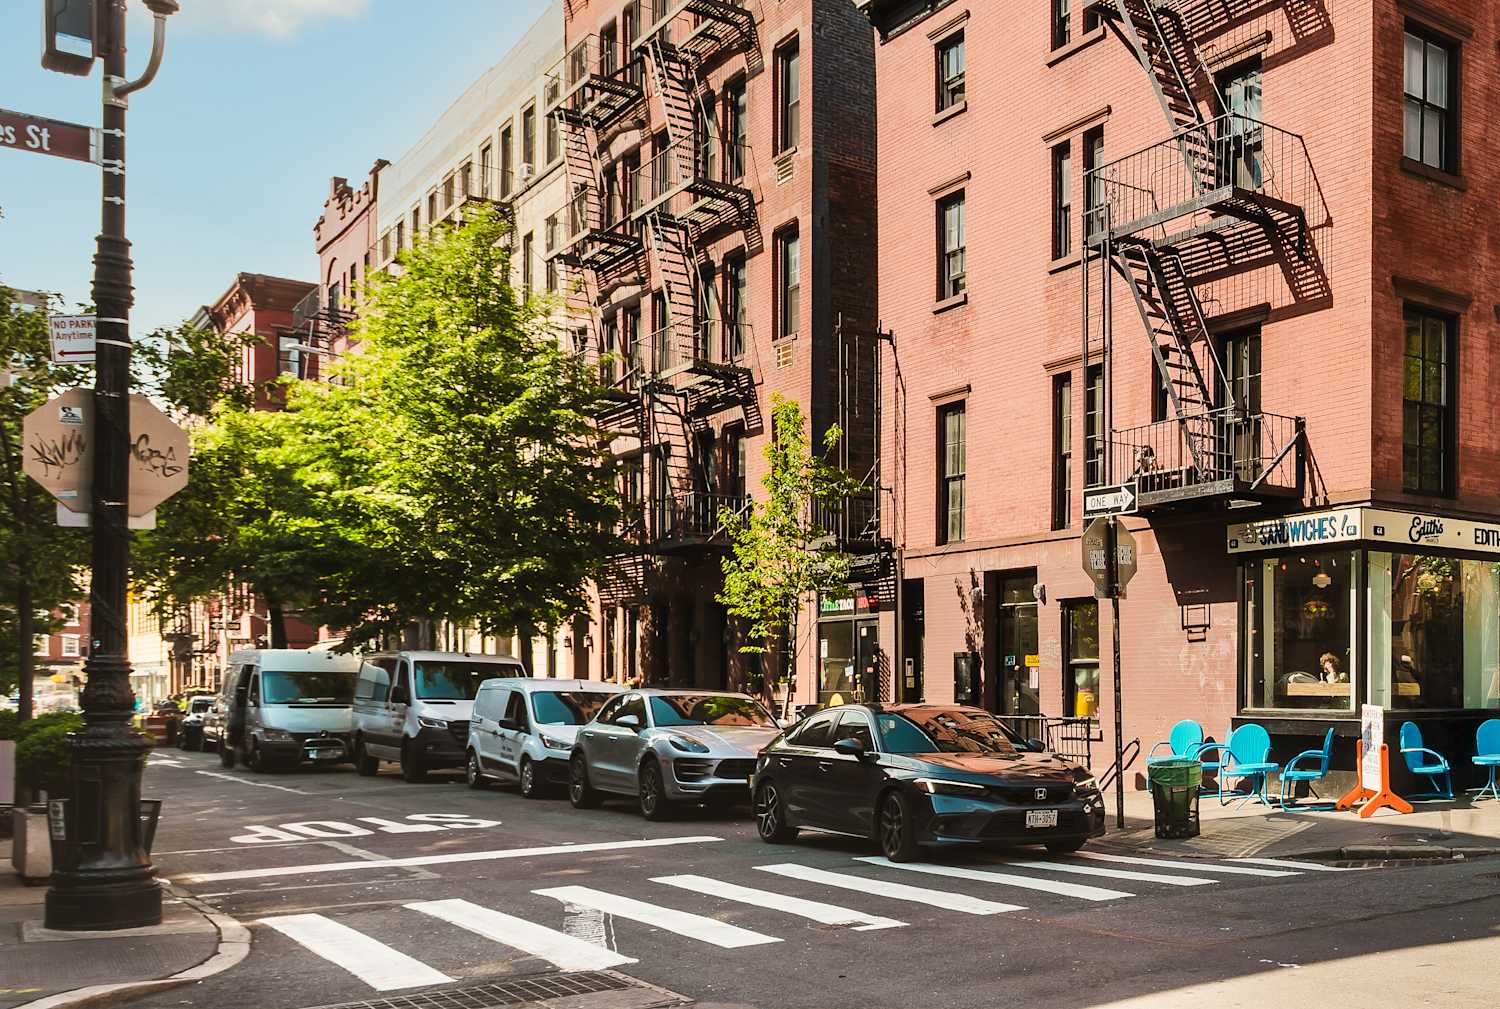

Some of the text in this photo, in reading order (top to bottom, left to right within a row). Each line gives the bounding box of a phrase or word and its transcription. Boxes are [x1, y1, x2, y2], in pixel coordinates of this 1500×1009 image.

[25, 124, 51, 152] St
[54, 319, 97, 329] NO PARK
[56, 331, 94, 342] Anytime
[1090, 493, 1129, 509] ONE WAY
[1259, 516, 1338, 546] SANDWICHES
[1408, 516, 1444, 543] Edith's
[229, 813, 502, 844] STOP
